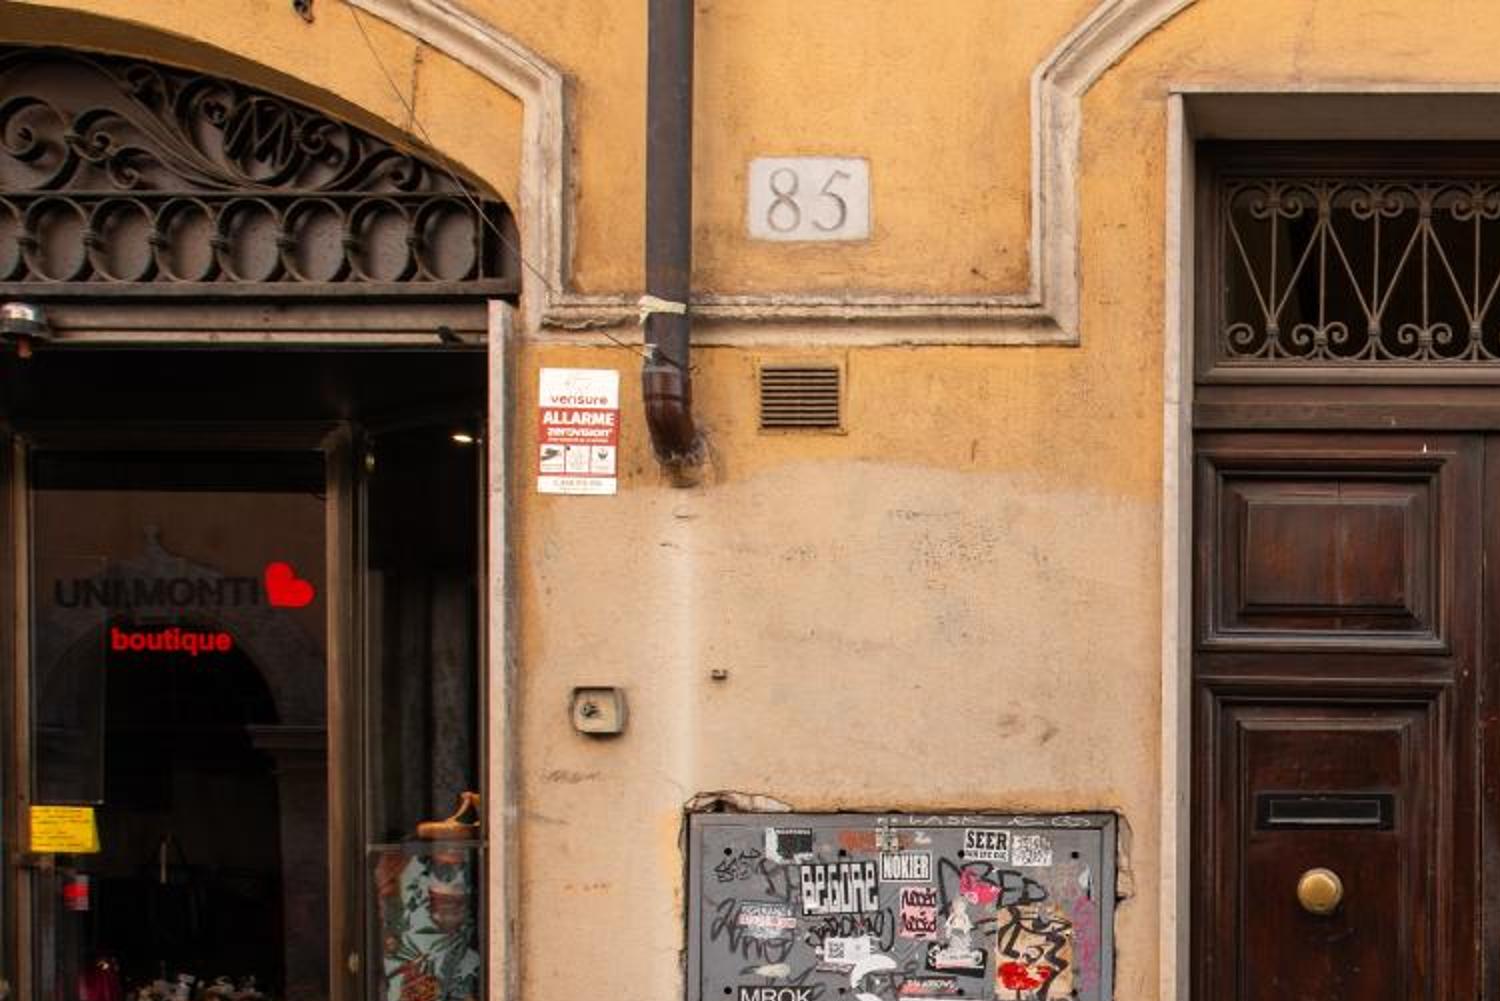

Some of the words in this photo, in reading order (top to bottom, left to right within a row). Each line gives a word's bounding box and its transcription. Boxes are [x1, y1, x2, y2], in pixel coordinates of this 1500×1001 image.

[766, 167, 851, 232] 85
[551, 395, 609, 405] verisure
[543, 410, 616, 426] ALLARME
[110, 626, 232, 656] boutique
[966, 831, 1007, 850] SEER
